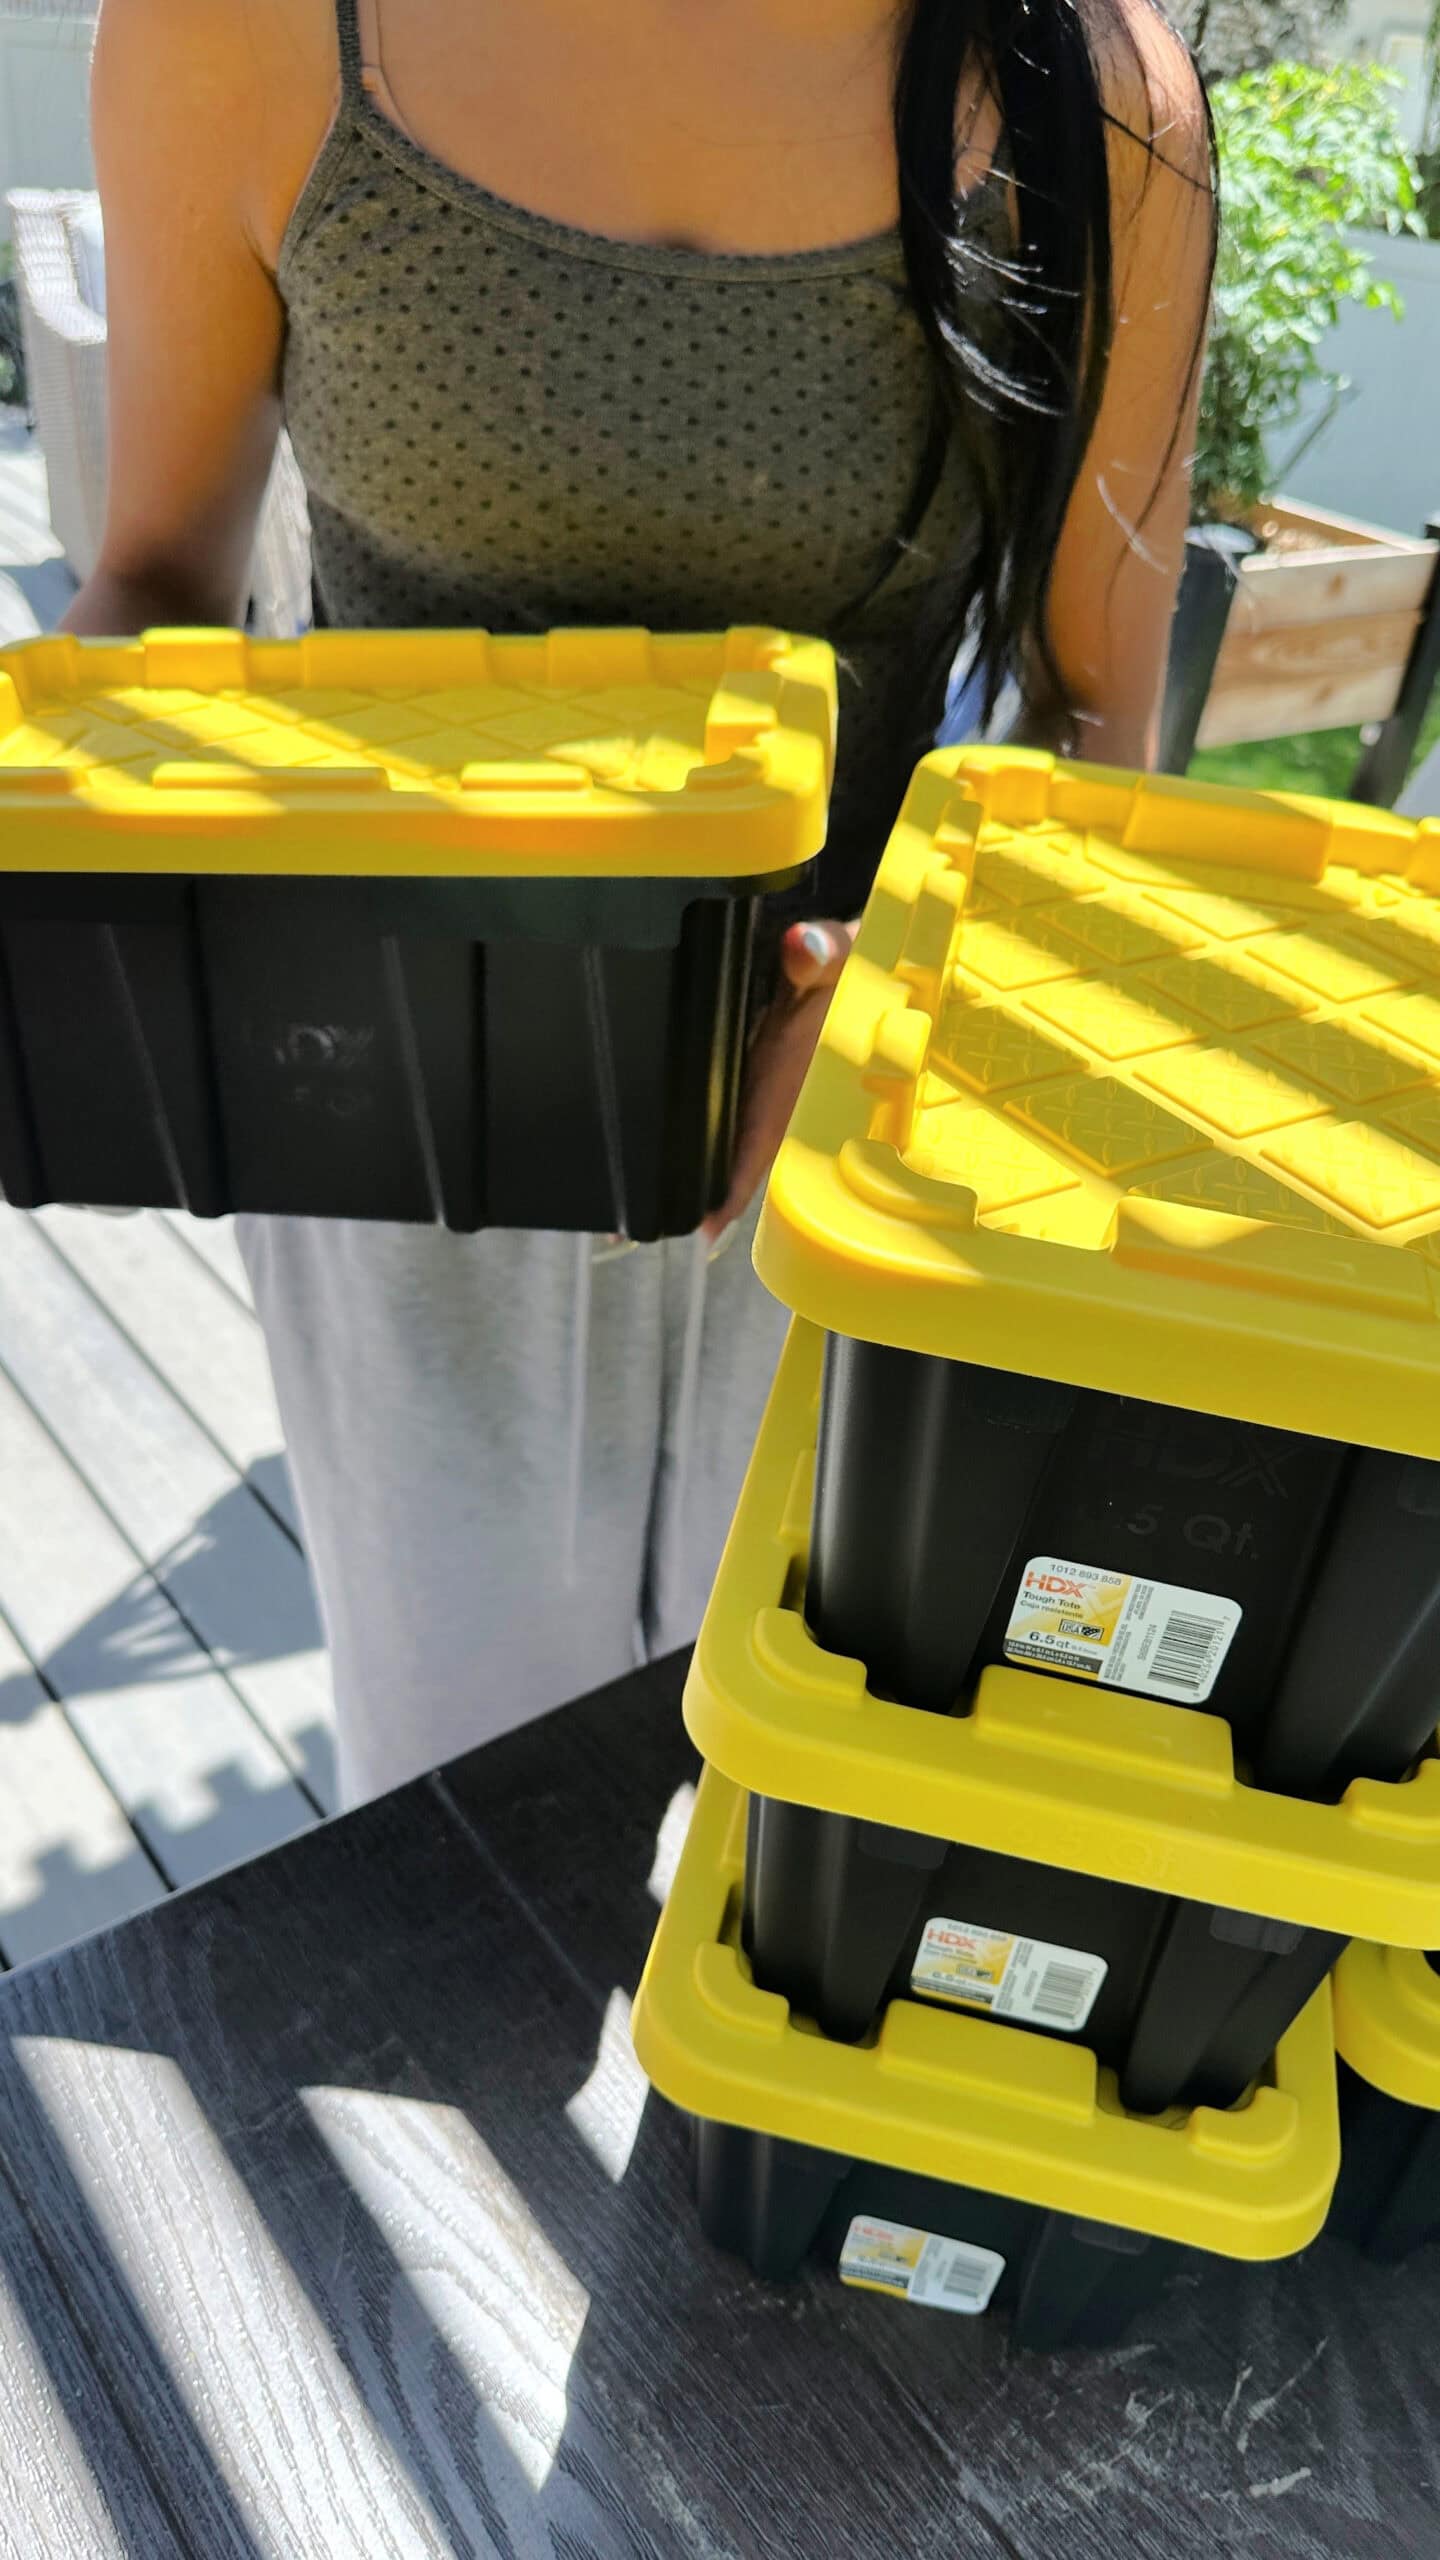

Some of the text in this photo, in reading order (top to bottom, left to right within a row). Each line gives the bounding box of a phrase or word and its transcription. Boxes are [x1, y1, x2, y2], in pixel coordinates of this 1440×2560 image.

[1050, 1563, 1077, 1576] 1012
[1025, 1571, 1087, 1599] HDX
[1023, 1590, 1081, 1610] Tough Tote
[1062, 1619, 1080, 1634] USA
[1029, 1631, 1056, 1645] 6.5
[1056, 1639, 1071, 1650] qt
